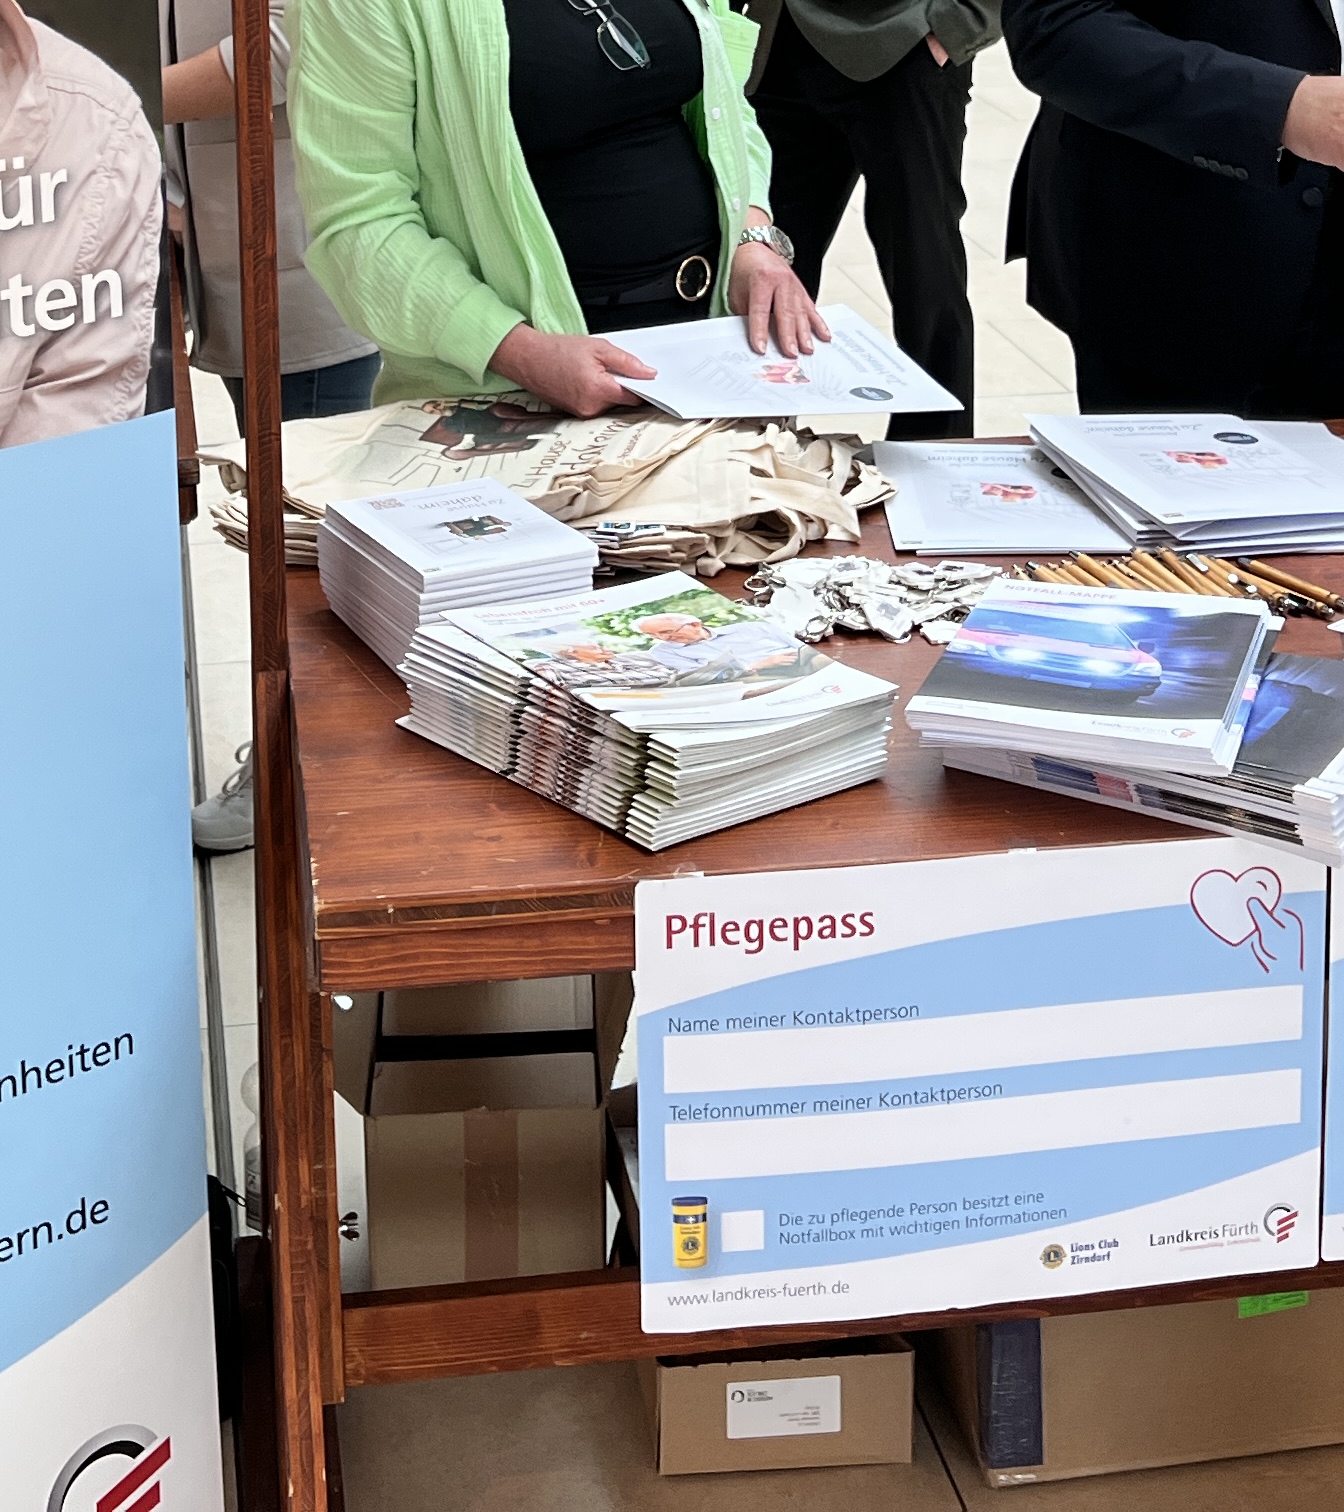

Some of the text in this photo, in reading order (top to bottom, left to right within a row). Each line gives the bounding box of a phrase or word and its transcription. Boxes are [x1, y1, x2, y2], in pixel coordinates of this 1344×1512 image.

[1004, 584, 1118, 600] NOTFALL-MAPPE
[663, 907, 876, 954] Pflegepass
[668, 1001, 921, 1034] Name meiner Kontaktperson
[669, 1081, 1004, 1123] Telefonnummer meiner Kontaktperson
[778, 1191, 1045, 1227] Die zu pflegende Person besitzt eine
[778, 1206, 1068, 1246] Notfallbox mit wichtigen Informationen
[1148, 1229, 1219, 1248] Landkreis
[1221, 1220, 1260, 1239] Fürth
[1070, 1238, 1120, 1254] Lions Club
[1070, 1252, 1112, 1266] Zirndorf
[667, 1280, 851, 1308] www.landkreis-fuerth.de
